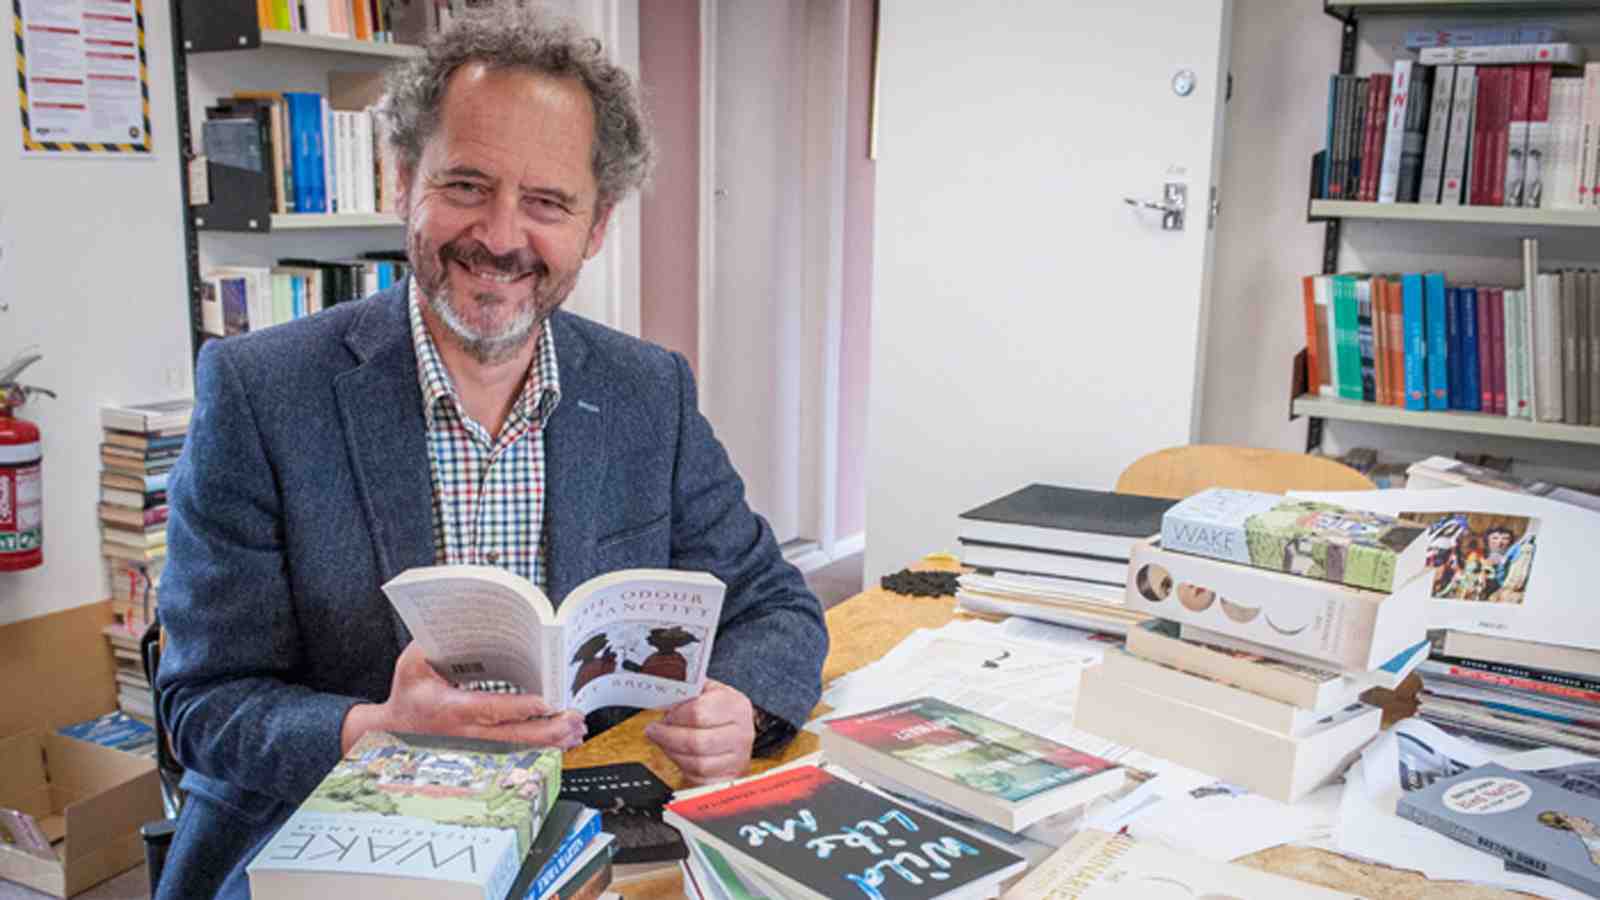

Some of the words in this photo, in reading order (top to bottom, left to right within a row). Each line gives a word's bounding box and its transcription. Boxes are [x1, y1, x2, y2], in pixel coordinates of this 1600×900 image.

[1173, 525, 1236, 548] WAKE
[621, 591, 703, 605] ODOUR
[611, 678, 687, 696] BROWN
[738, 808, 818, 847] Me
[806, 809, 919, 858] Like
[270, 832, 477, 873] WAKE
